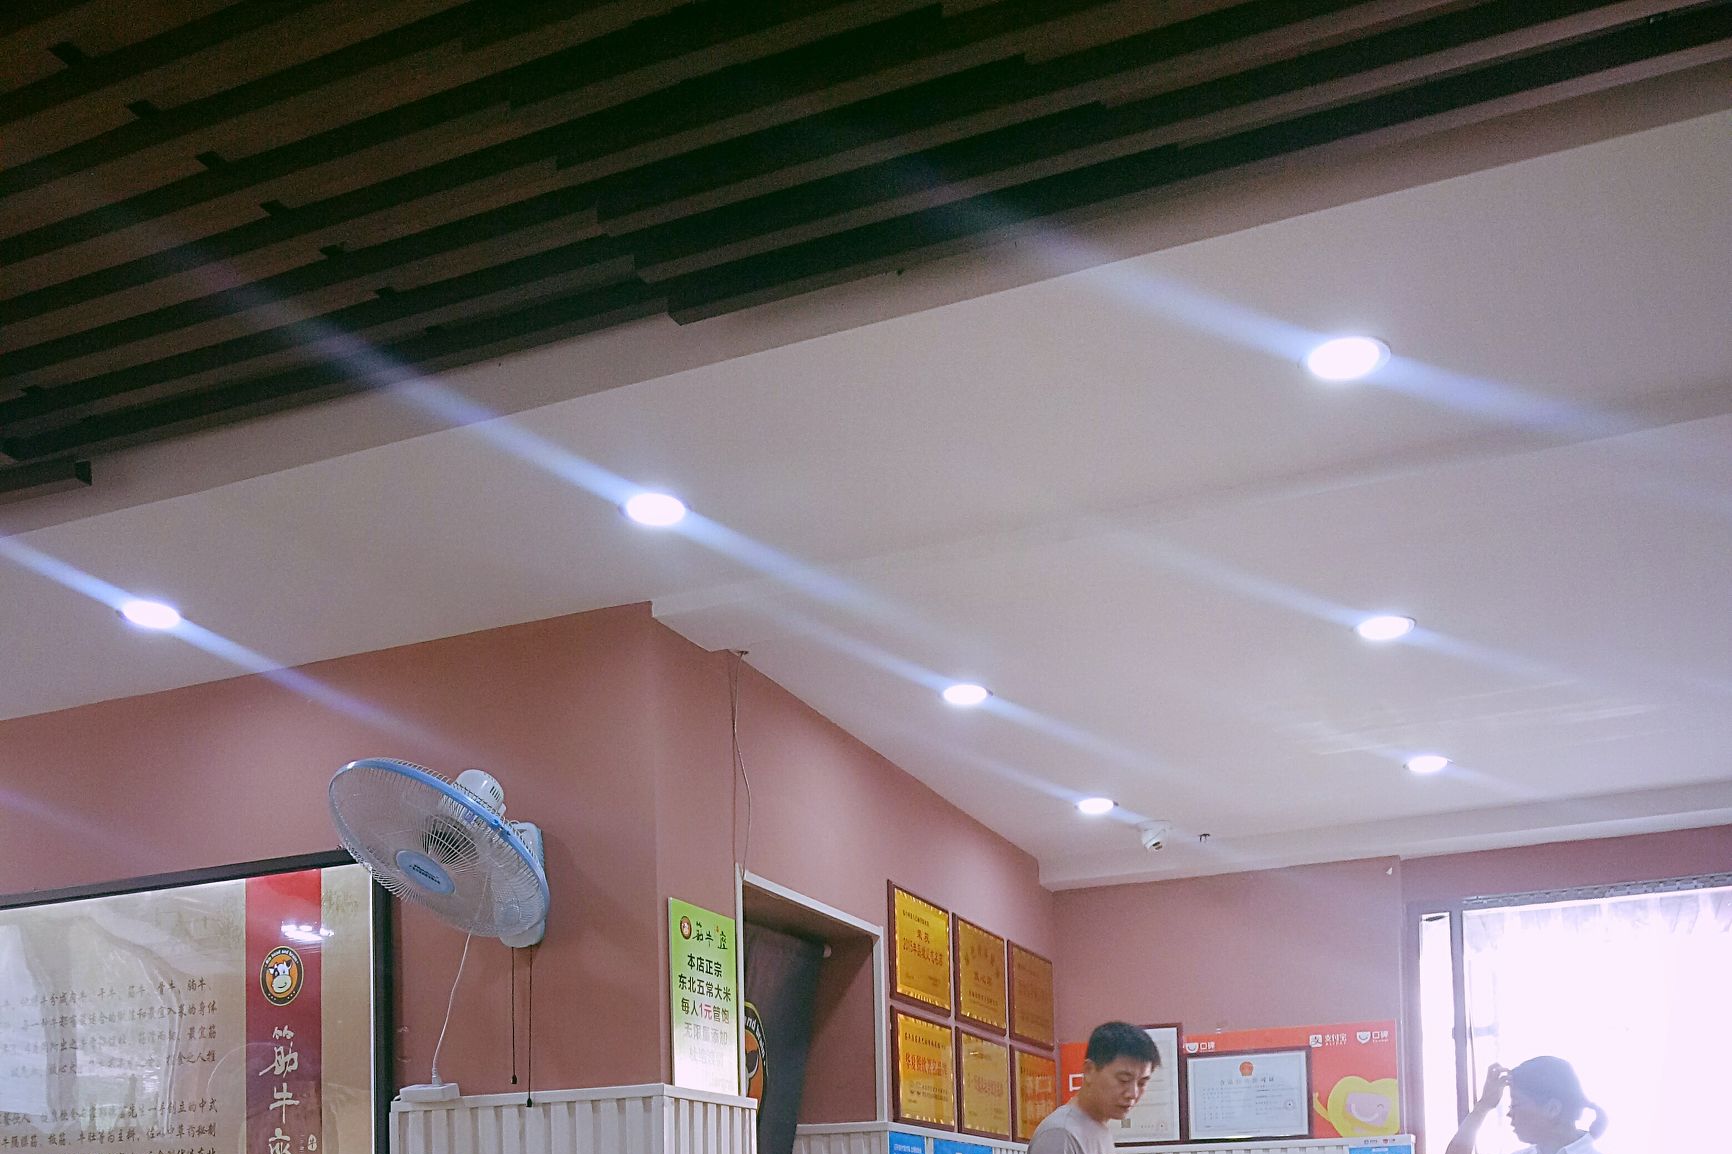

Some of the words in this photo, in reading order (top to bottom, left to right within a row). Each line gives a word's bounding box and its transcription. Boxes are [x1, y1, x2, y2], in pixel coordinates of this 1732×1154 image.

[687, 953, 723, 978] 本店正宗
[678, 973, 731, 1002] 东北五常大米
[681, 997, 730, 1024] 每人1元管饱
